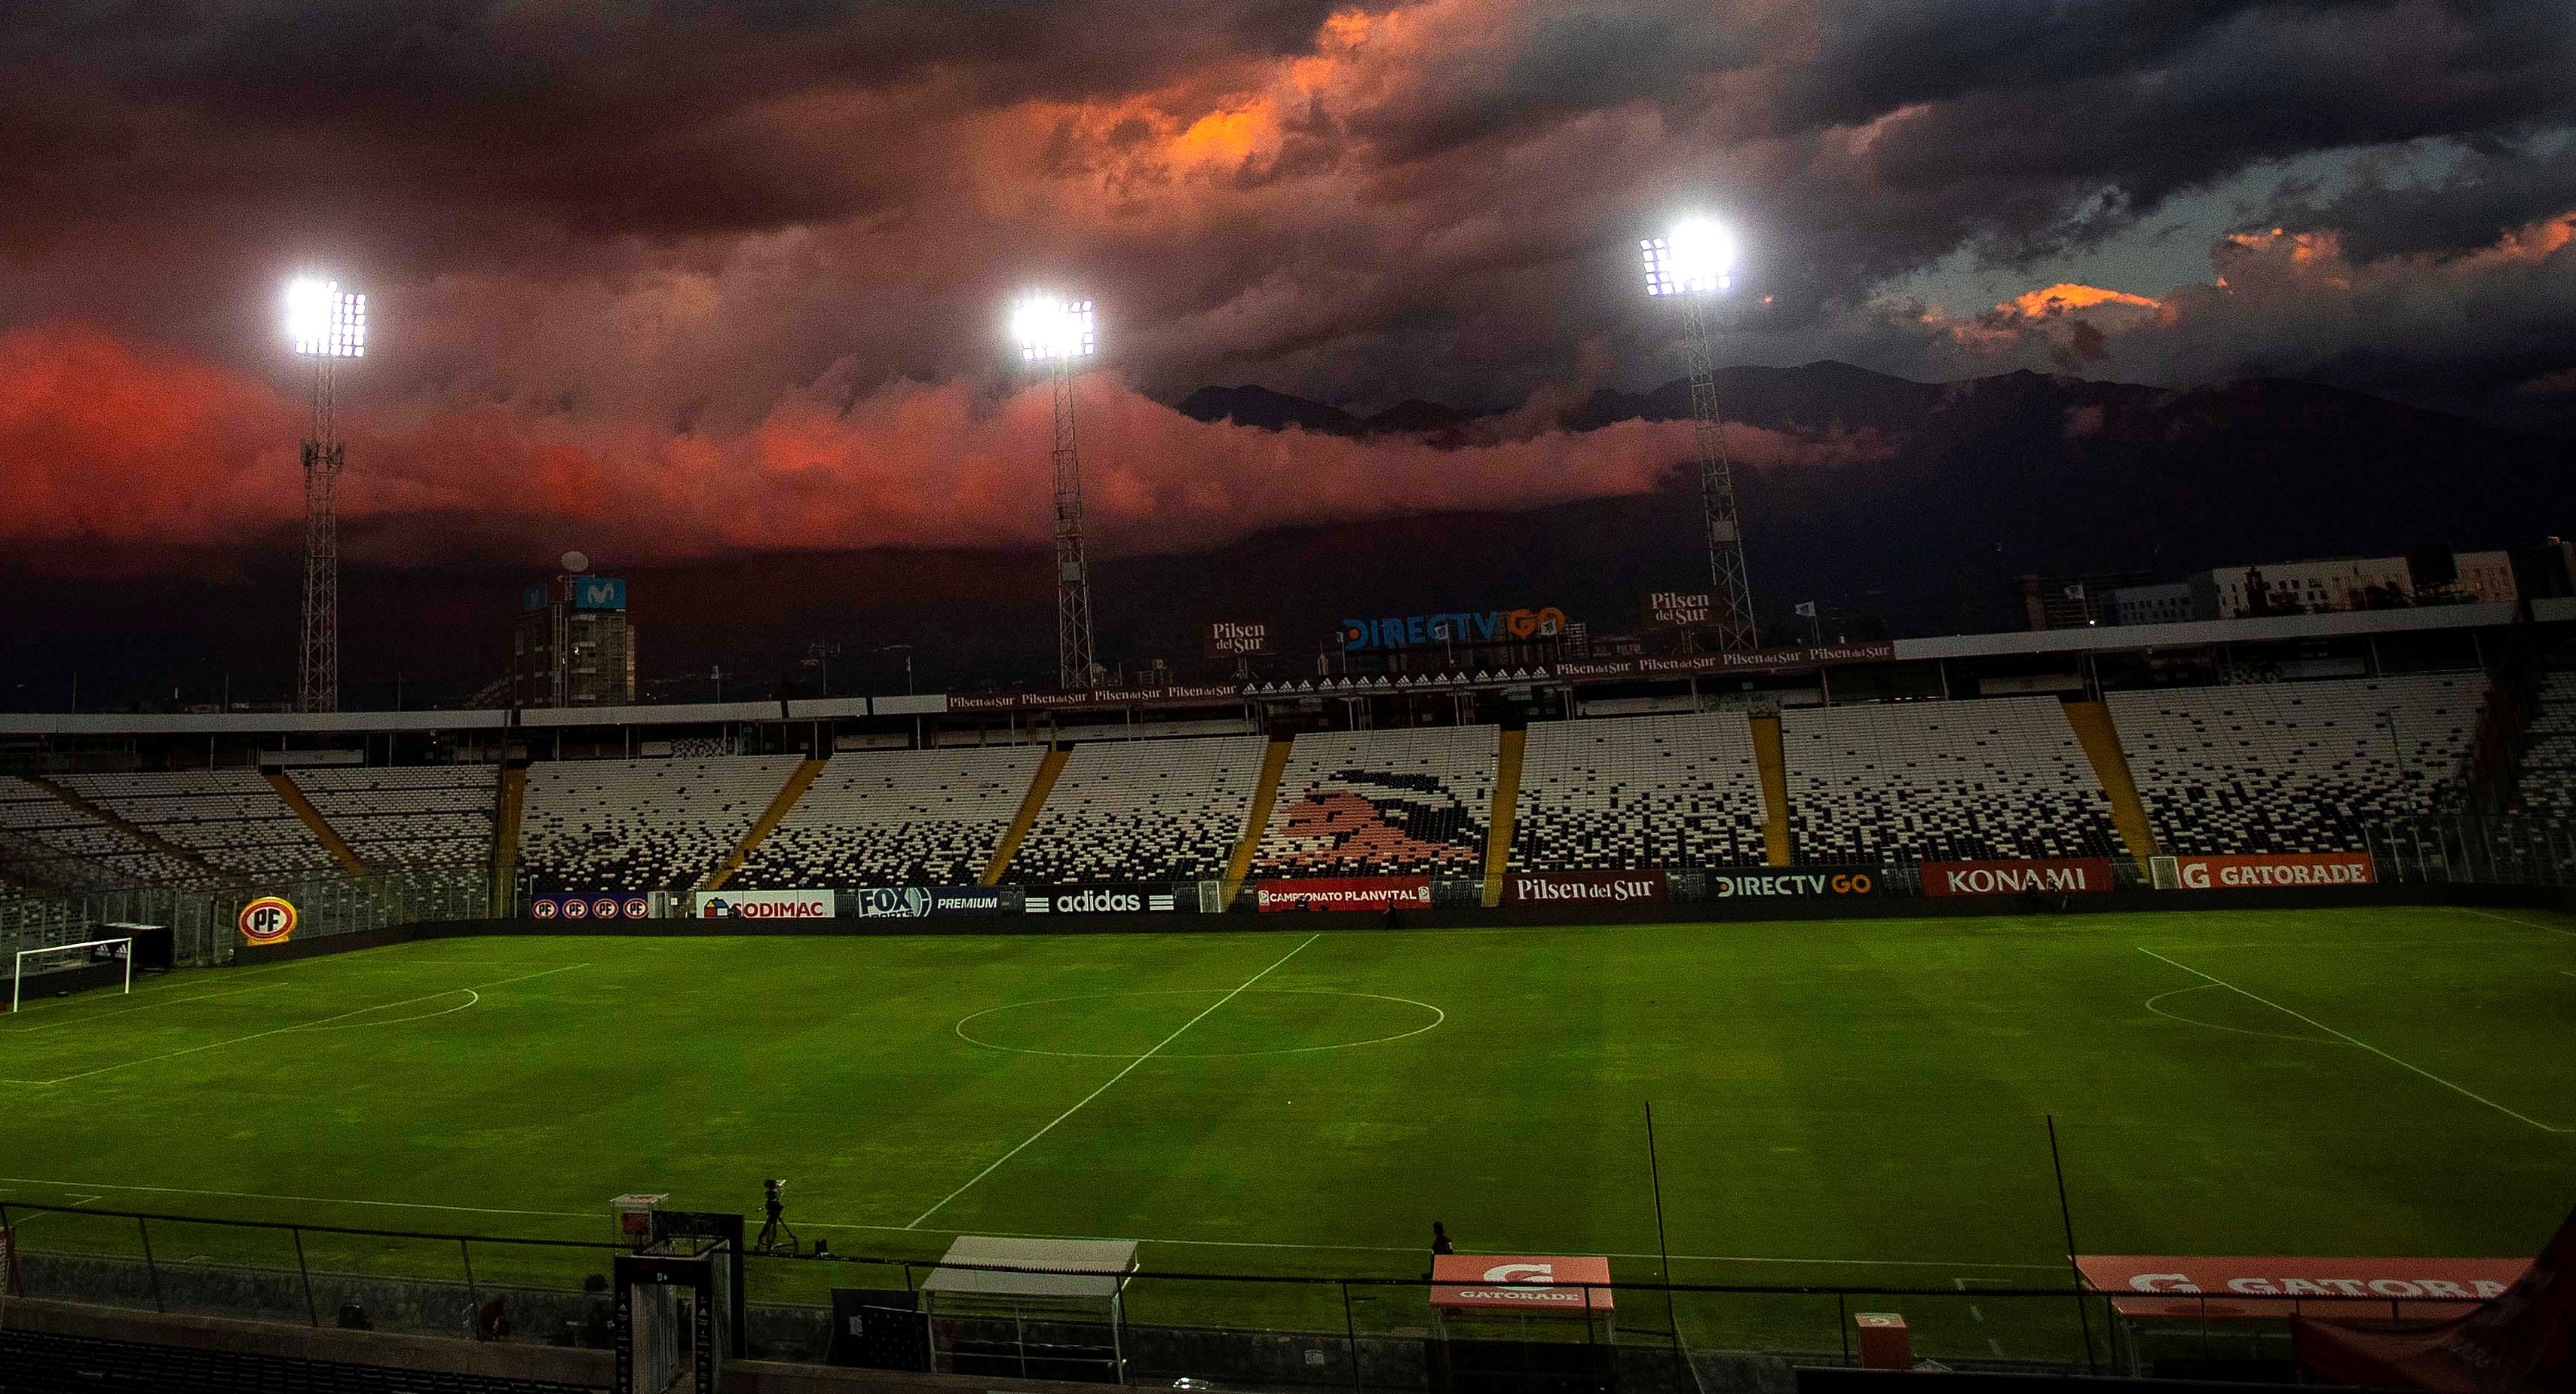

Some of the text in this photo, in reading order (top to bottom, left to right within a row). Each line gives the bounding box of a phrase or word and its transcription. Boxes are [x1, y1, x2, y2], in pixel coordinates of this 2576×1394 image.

[1651, 592, 1709, 609] Pilsen
[1656, 608, 1708, 625] del Sur
[1212, 623, 1265, 639] Pilsen
[1342, 607, 1566, 651] DIRECTV GO
[1216, 638, 1263, 654] del Sur
[1809, 648, 1852, 660] Pilsen
[1866, 646, 1891, 658] Sur
[1639, 658, 1679, 671] Pilsen
[1692, 657, 1717, 669] Sur
[1723, 653, 1763, 666] Pilsen
[1778, 651, 1802, 663] Sur
[1556, 663, 1594, 676] Pilsen
[1609, 662, 1632, 674] Sur
[1022, 694, 1055, 705] Pilsen
[1068, 692, 1089, 704] Sur
[1095, 690, 1129, 701] Pilsen
[1142, 688, 1162, 700] Sur
[1169, 685, 1203, 698] Pilsen
[1216, 685, 1237, 697] Sur
[949, 697, 983, 708] Pilsen
[995, 696, 1015, 707] Sur
[1947, 868, 2086, 893] KONAMI
[2182, 862, 2367, 888] G GATORADE
[1516, 878, 1655, 901] Pilsen del Sur
[1715, 873, 1873, 898] DIRECTV GO
[860, 887, 912, 915] FOX
[937, 897, 998, 909] PREMIUM
[1056, 889, 1141, 913] adidas
[1344, 890, 1417, 901] PLANVITAL
[539, 905, 552, 915] PF
[569, 904, 582, 915] PF
[599, 904, 612, 914] PF
[629, 903, 643, 914] PF
[731, 902, 823, 918] SODIMAC
[254, 908, 280, 932] PF
[1483, 1264, 1554, 1291] G
[2128, 1273, 2202, 1294] G
[1460, 1291, 1579, 1301] GATORADE
